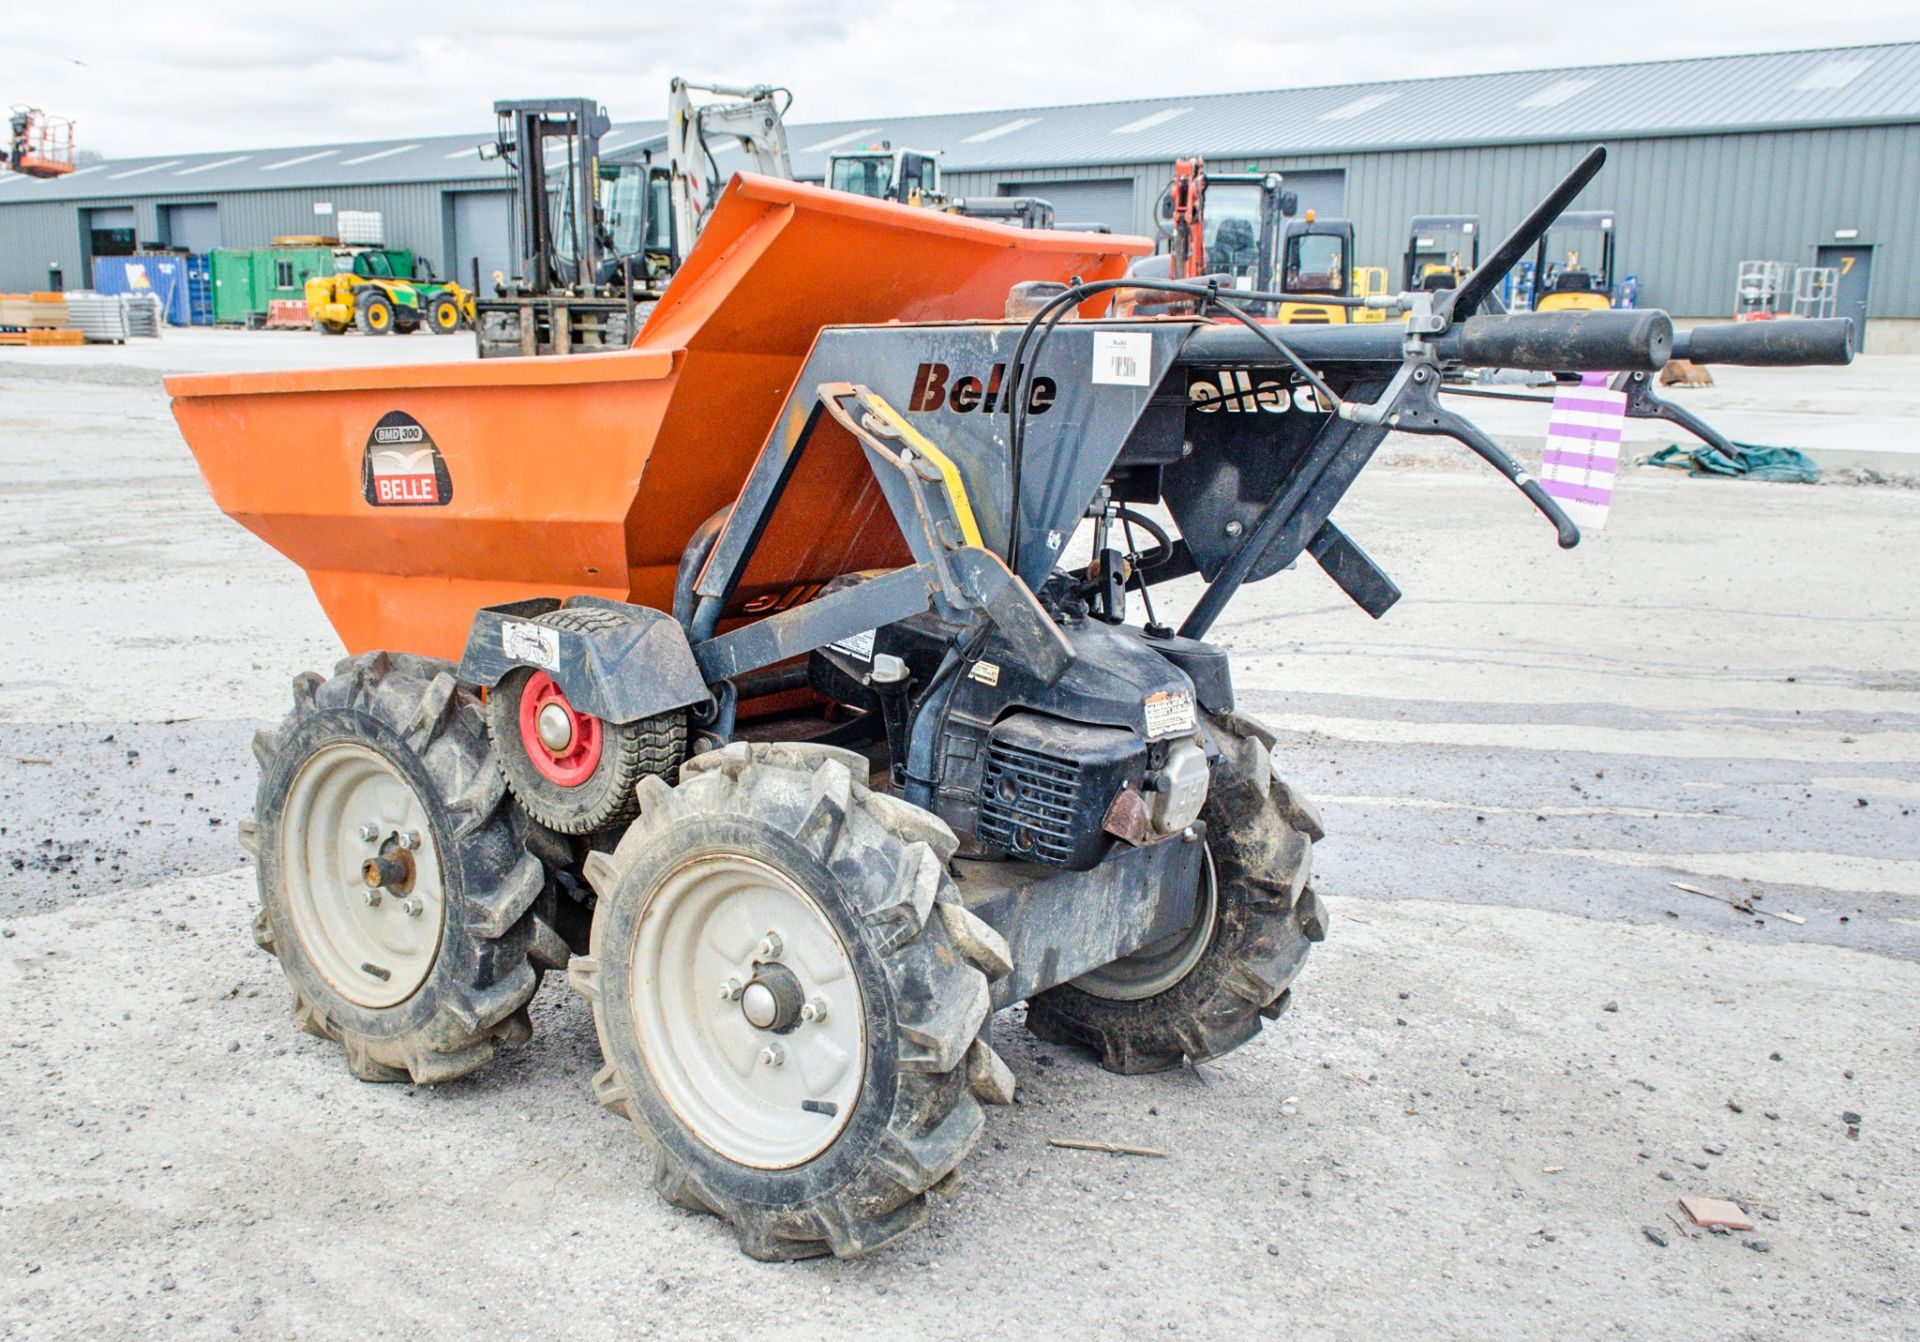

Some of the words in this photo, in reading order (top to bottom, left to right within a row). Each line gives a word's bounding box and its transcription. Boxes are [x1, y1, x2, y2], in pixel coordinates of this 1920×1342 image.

[1840, 256, 1857, 276] 7
[908, 363, 1057, 415] Belle
[378, 429, 400, 441] BMD
[402, 428, 419, 440] 300
[380, 479, 433, 500] BELLE
